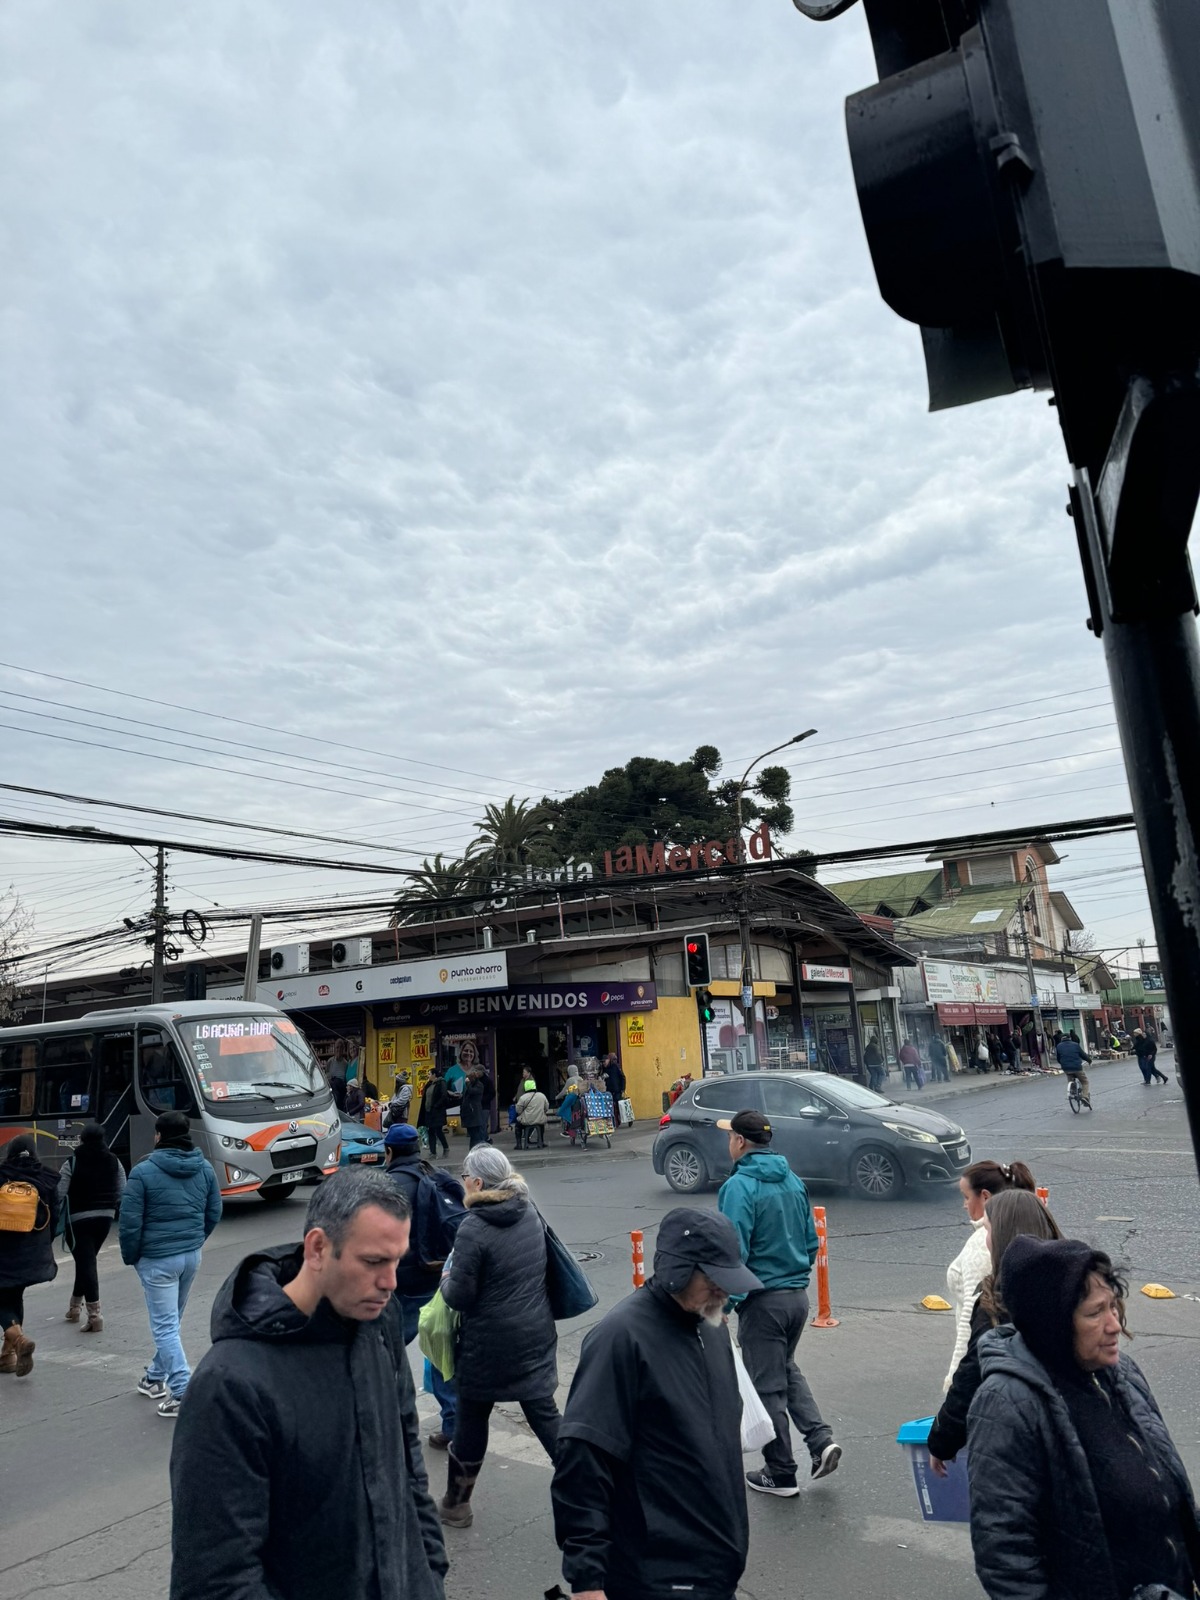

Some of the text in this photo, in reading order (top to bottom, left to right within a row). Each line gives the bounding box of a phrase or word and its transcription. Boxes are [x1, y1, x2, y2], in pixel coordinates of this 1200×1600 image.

[451, 964, 502, 979] punto ahorro
[458, 992, 588, 1014] BIENVENIDOS
[610, 993, 625, 1002] pepsi
[216, 1088, 224, 1098] 6
